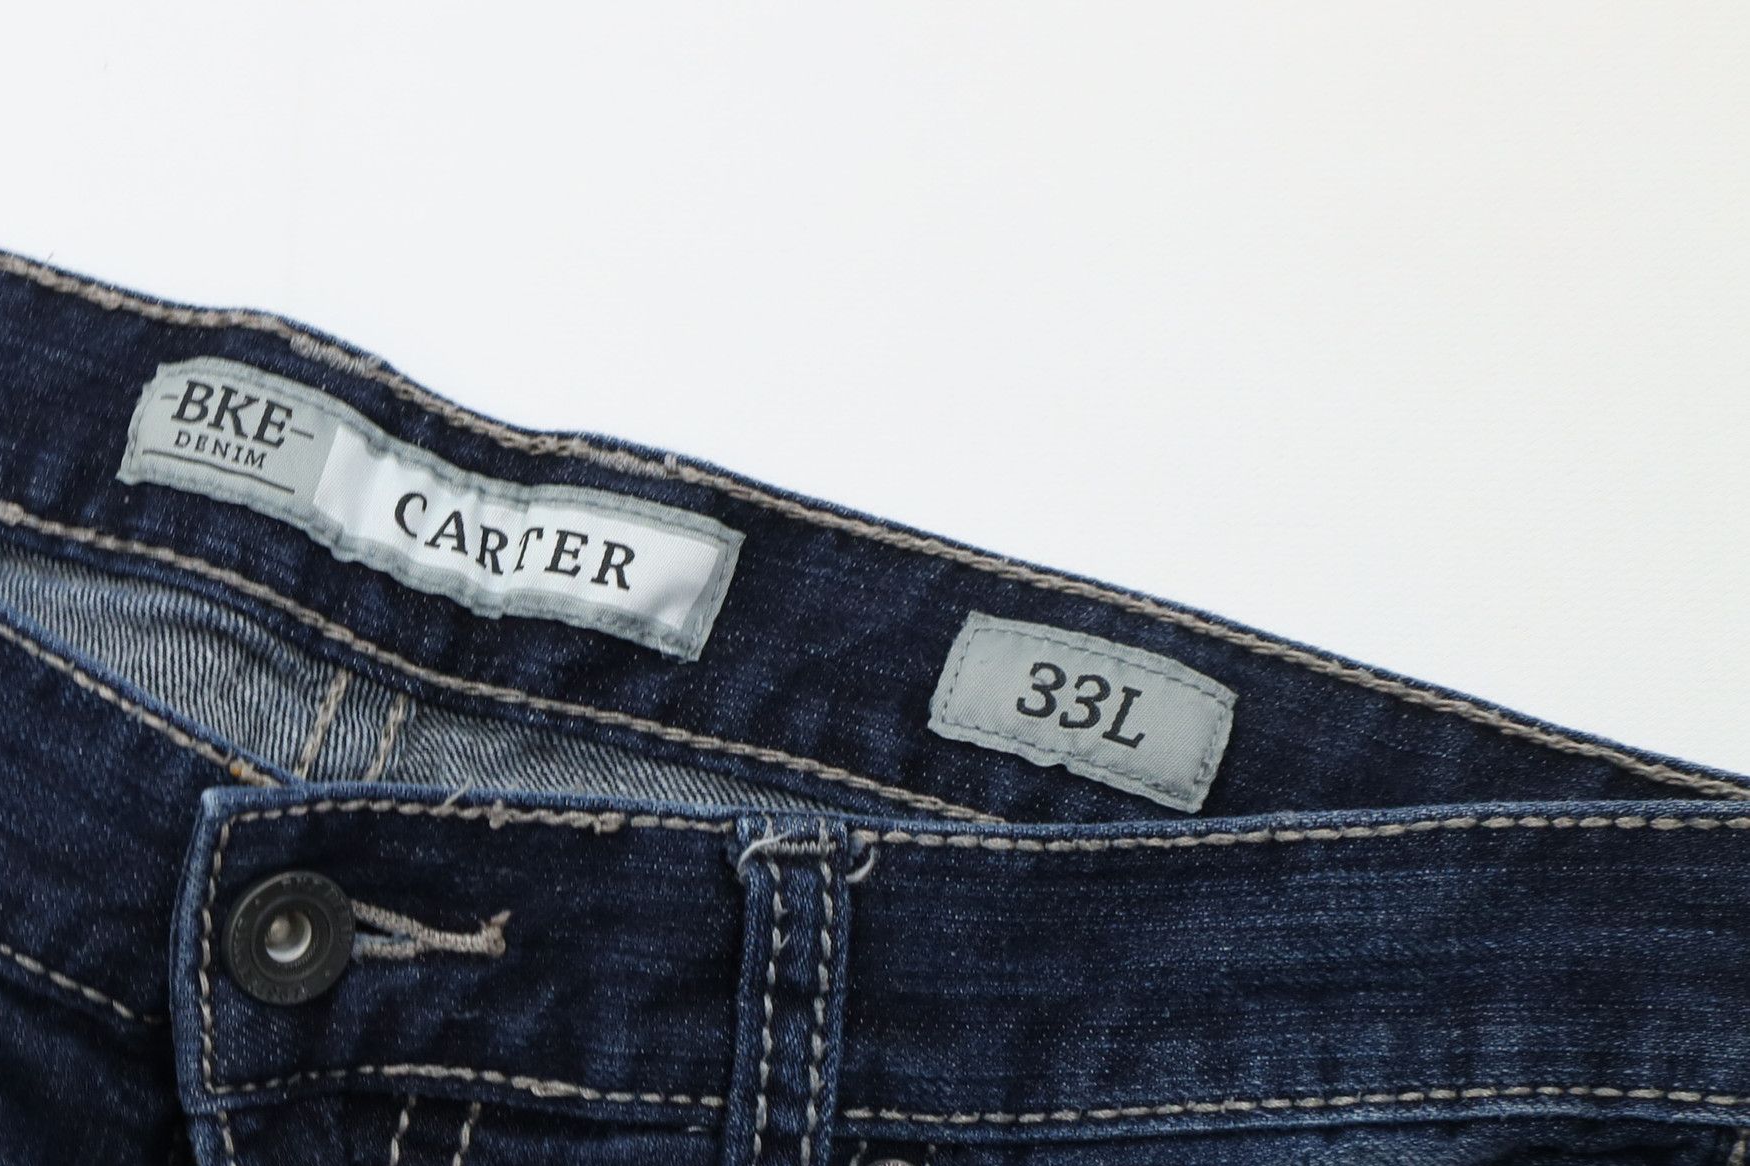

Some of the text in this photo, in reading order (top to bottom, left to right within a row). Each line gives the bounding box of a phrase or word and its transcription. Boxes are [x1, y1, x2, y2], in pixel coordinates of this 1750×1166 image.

[170, 379, 293, 450] BKE
[173, 430, 268, 469] DENIM
[394, 491, 636, 591] CARTER
[1016, 661, 1146, 749] 33L
